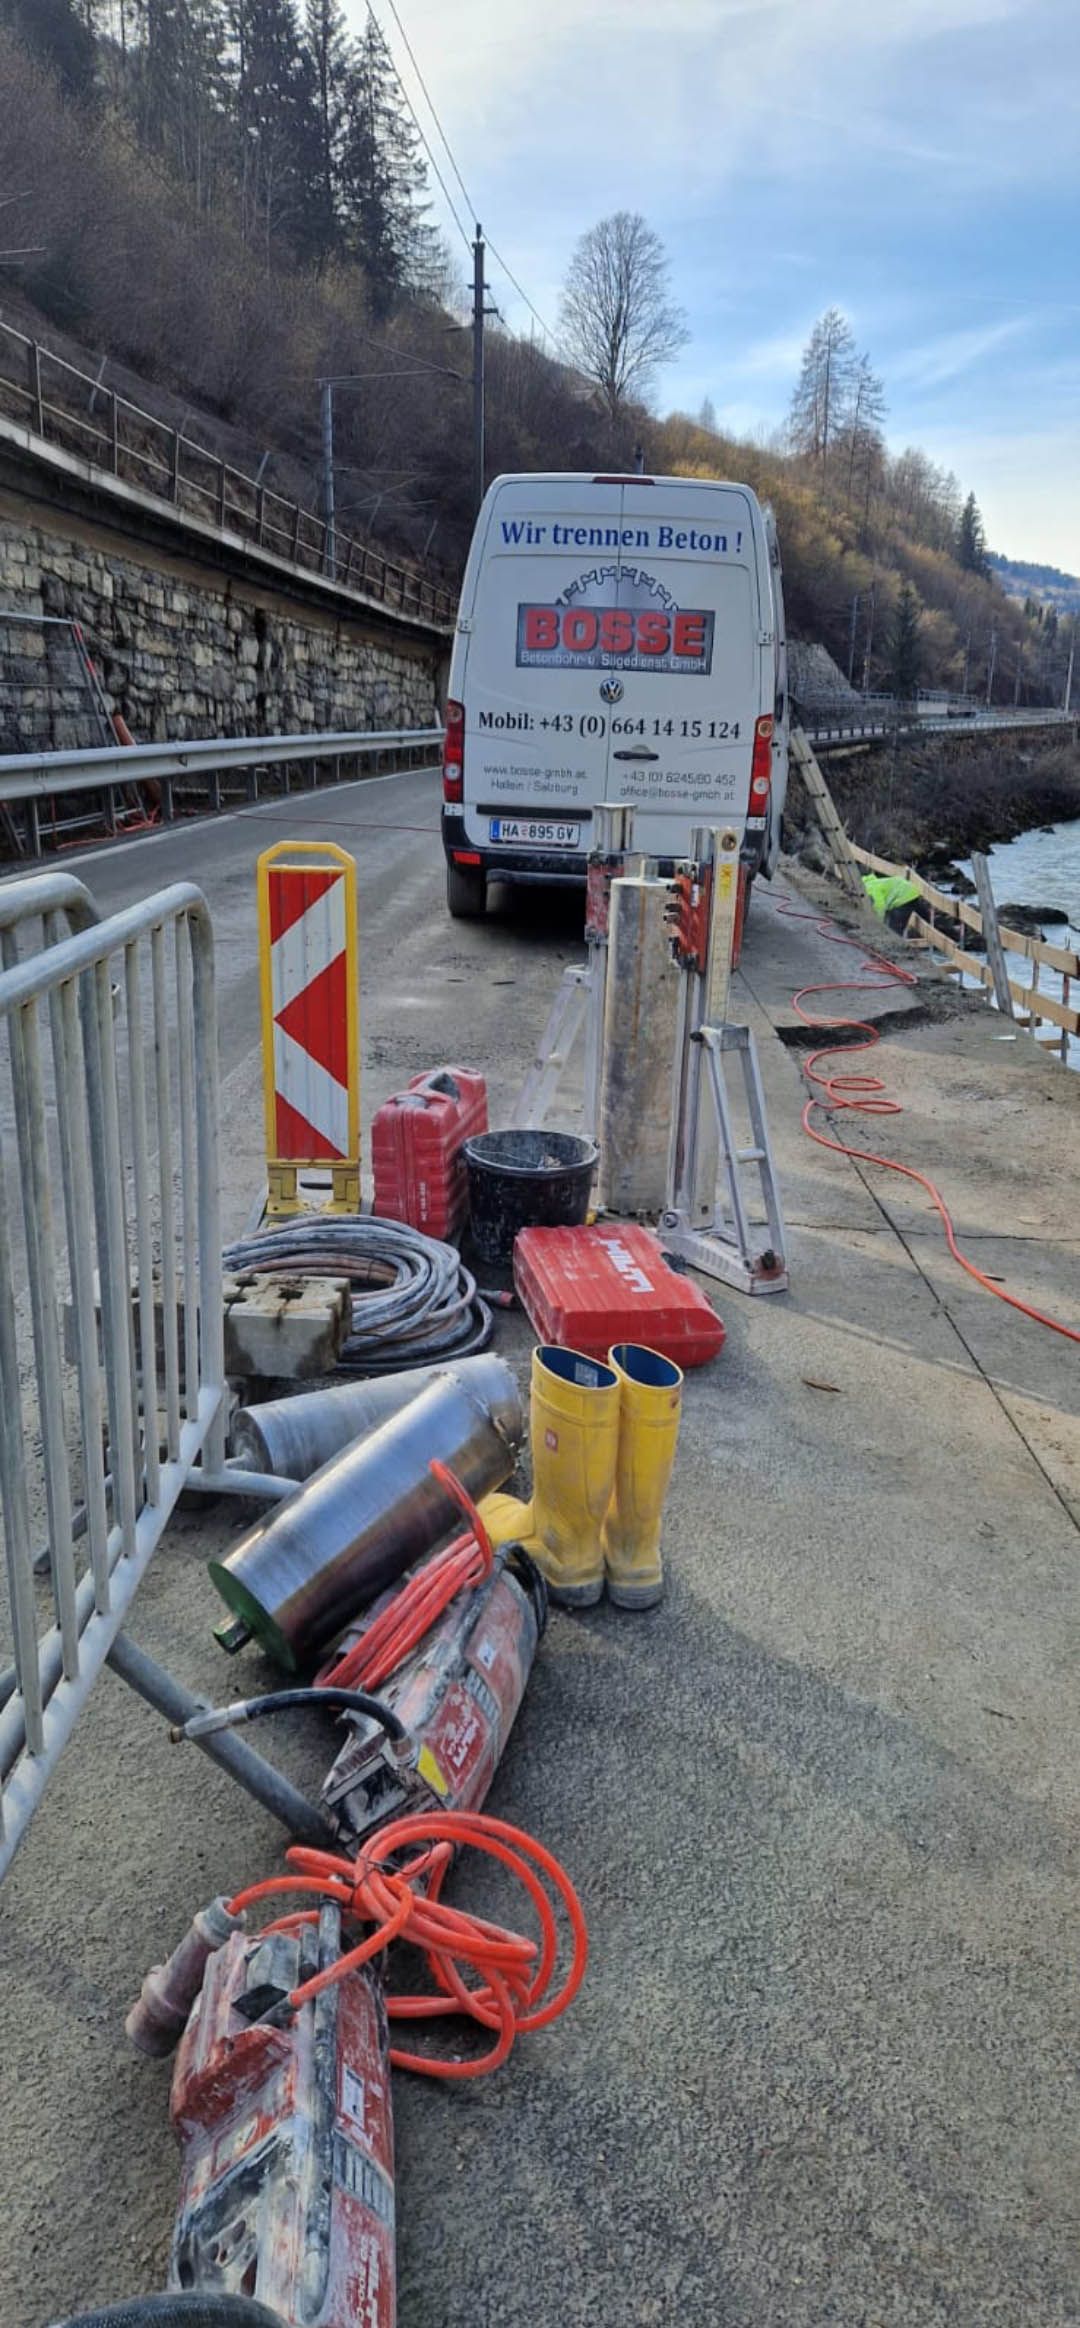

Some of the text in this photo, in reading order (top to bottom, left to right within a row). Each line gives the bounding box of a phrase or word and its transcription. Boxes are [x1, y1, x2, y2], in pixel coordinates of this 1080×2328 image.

[501, 521, 743, 553] Wir trennen Beton !
[524, 607, 707, 657] BOSSE
[670, 657, 707, 670] GmbH
[478, 711, 741, 740] Mobil: +43 (0) 664 14 15 124
[533, 780, 579, 796] Salzburg
[648, 770, 663, 783] (0)
[714, 773, 736, 786] 452
[502, 823, 519, 837] HA
[528, 825, 554, 840] 895
[557, 826, 574, 840] GV
[597, 1239, 655, 1293] HILTI
